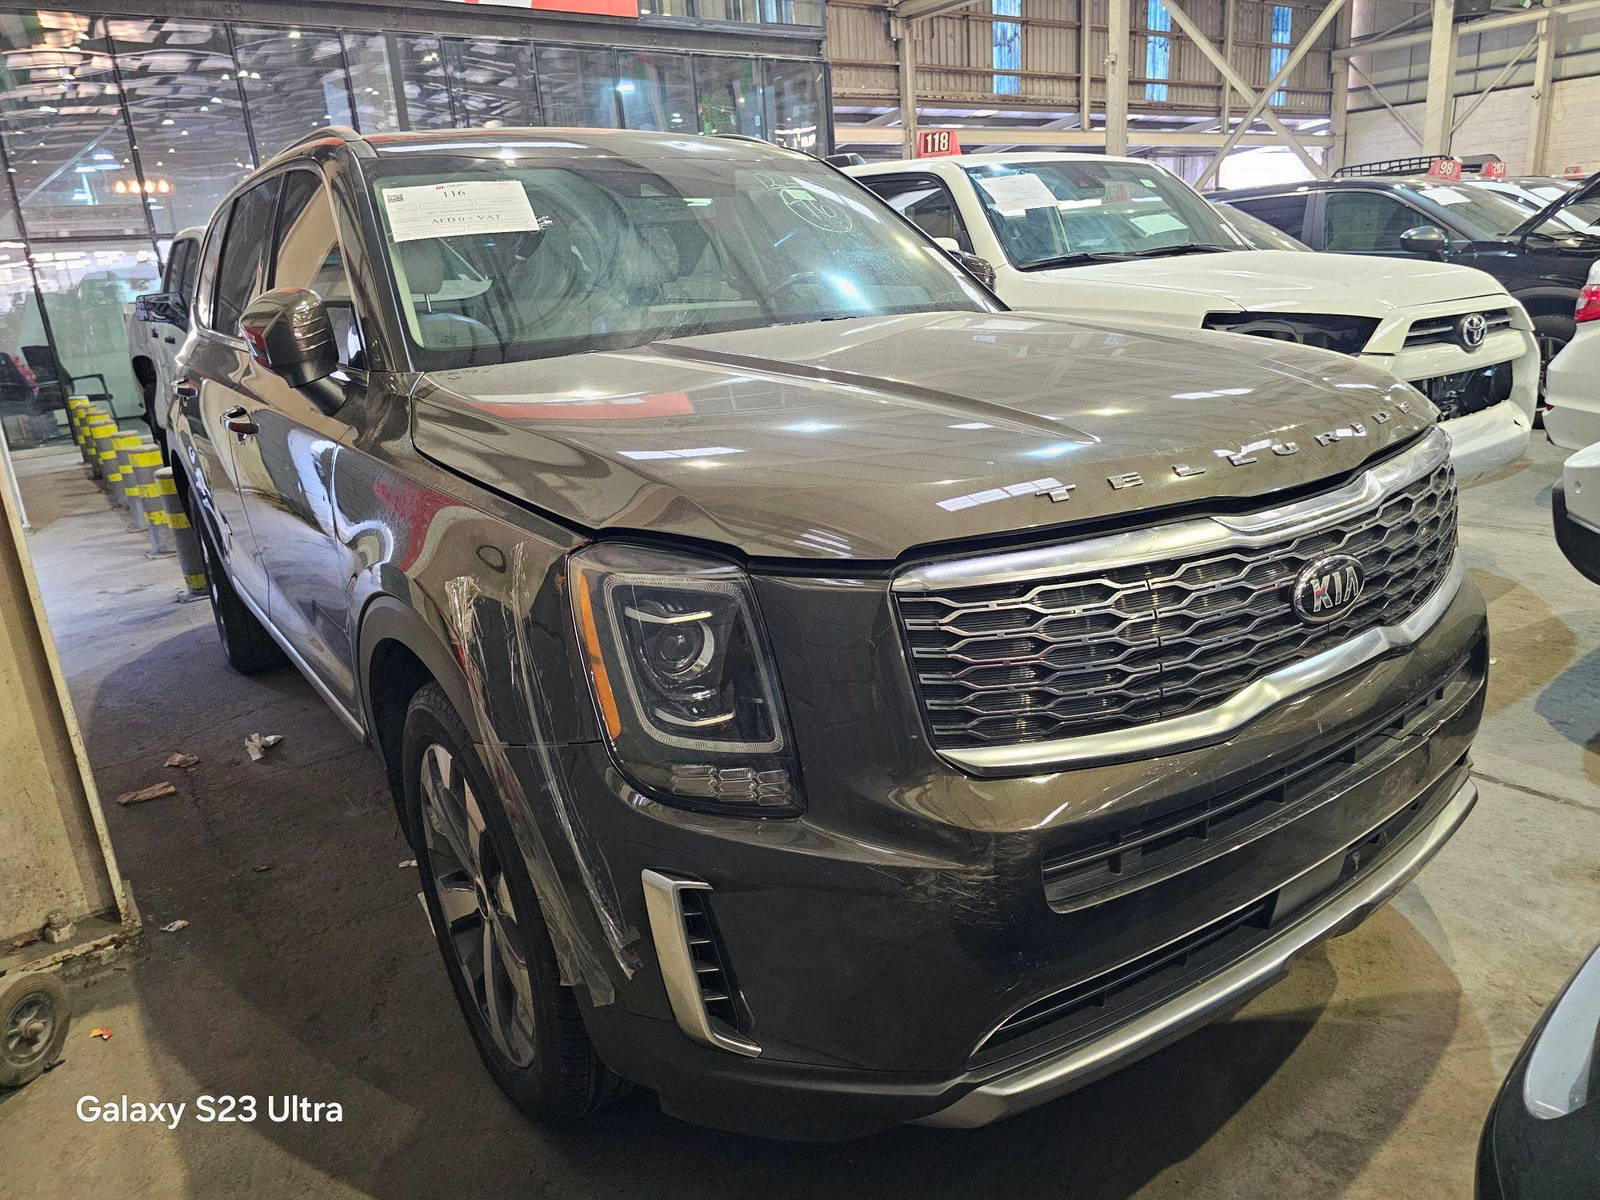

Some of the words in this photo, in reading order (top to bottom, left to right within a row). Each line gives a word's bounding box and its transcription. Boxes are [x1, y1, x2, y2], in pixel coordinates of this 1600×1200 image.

[926, 132, 948, 153] 118
[1439, 161, 1454, 175] 98
[443, 190, 466, 198] 116
[1310, 566, 1359, 613] KIA
